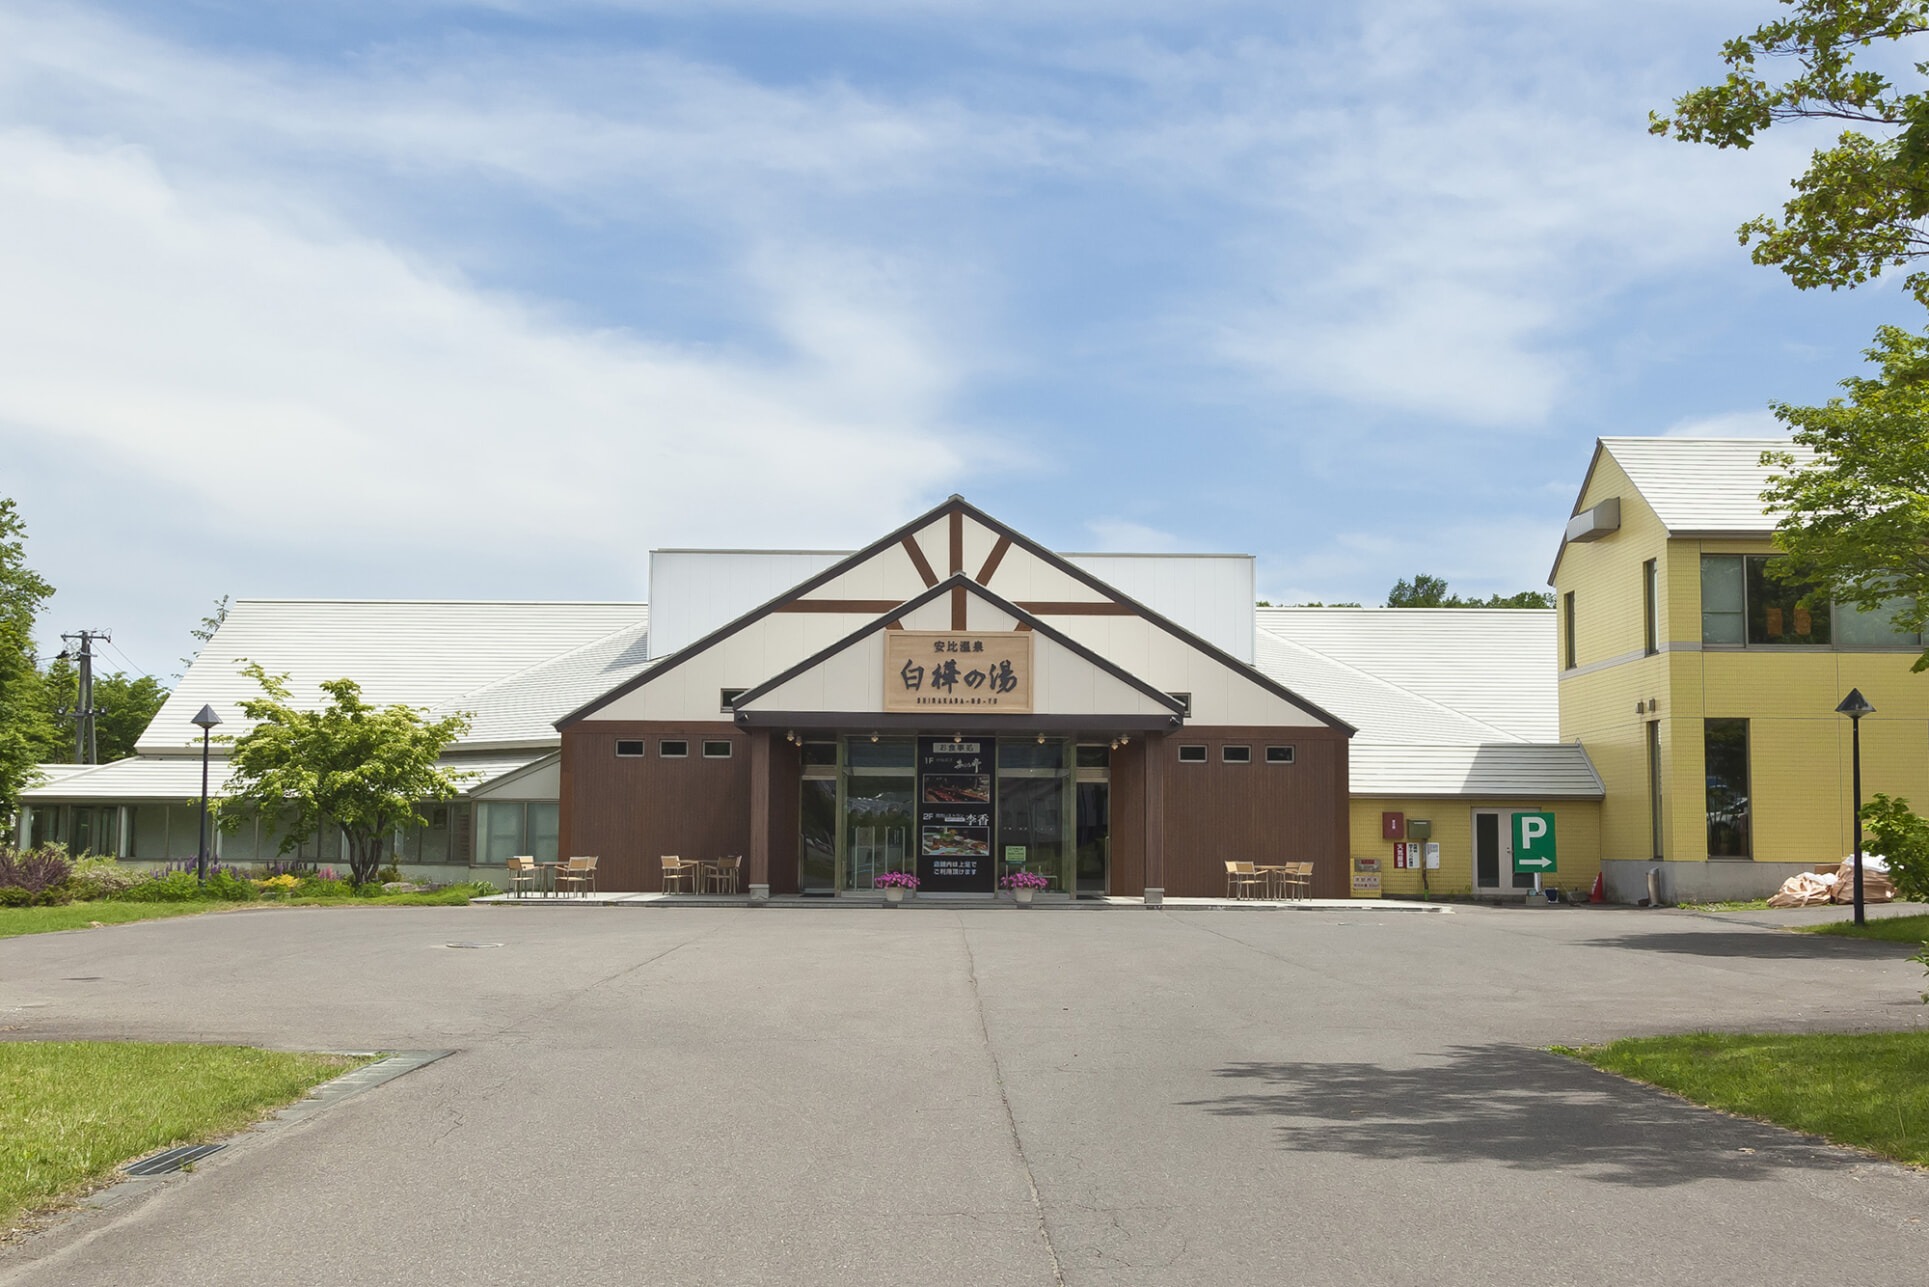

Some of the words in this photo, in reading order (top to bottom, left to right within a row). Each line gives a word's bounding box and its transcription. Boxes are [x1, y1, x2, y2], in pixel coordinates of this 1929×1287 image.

[933, 640, 984, 653] 安比温泉
[900, 658, 1018, 694] 白樺の湯
[923, 812, 934, 821] 2F
[1521, 816, 1547, 849] P
